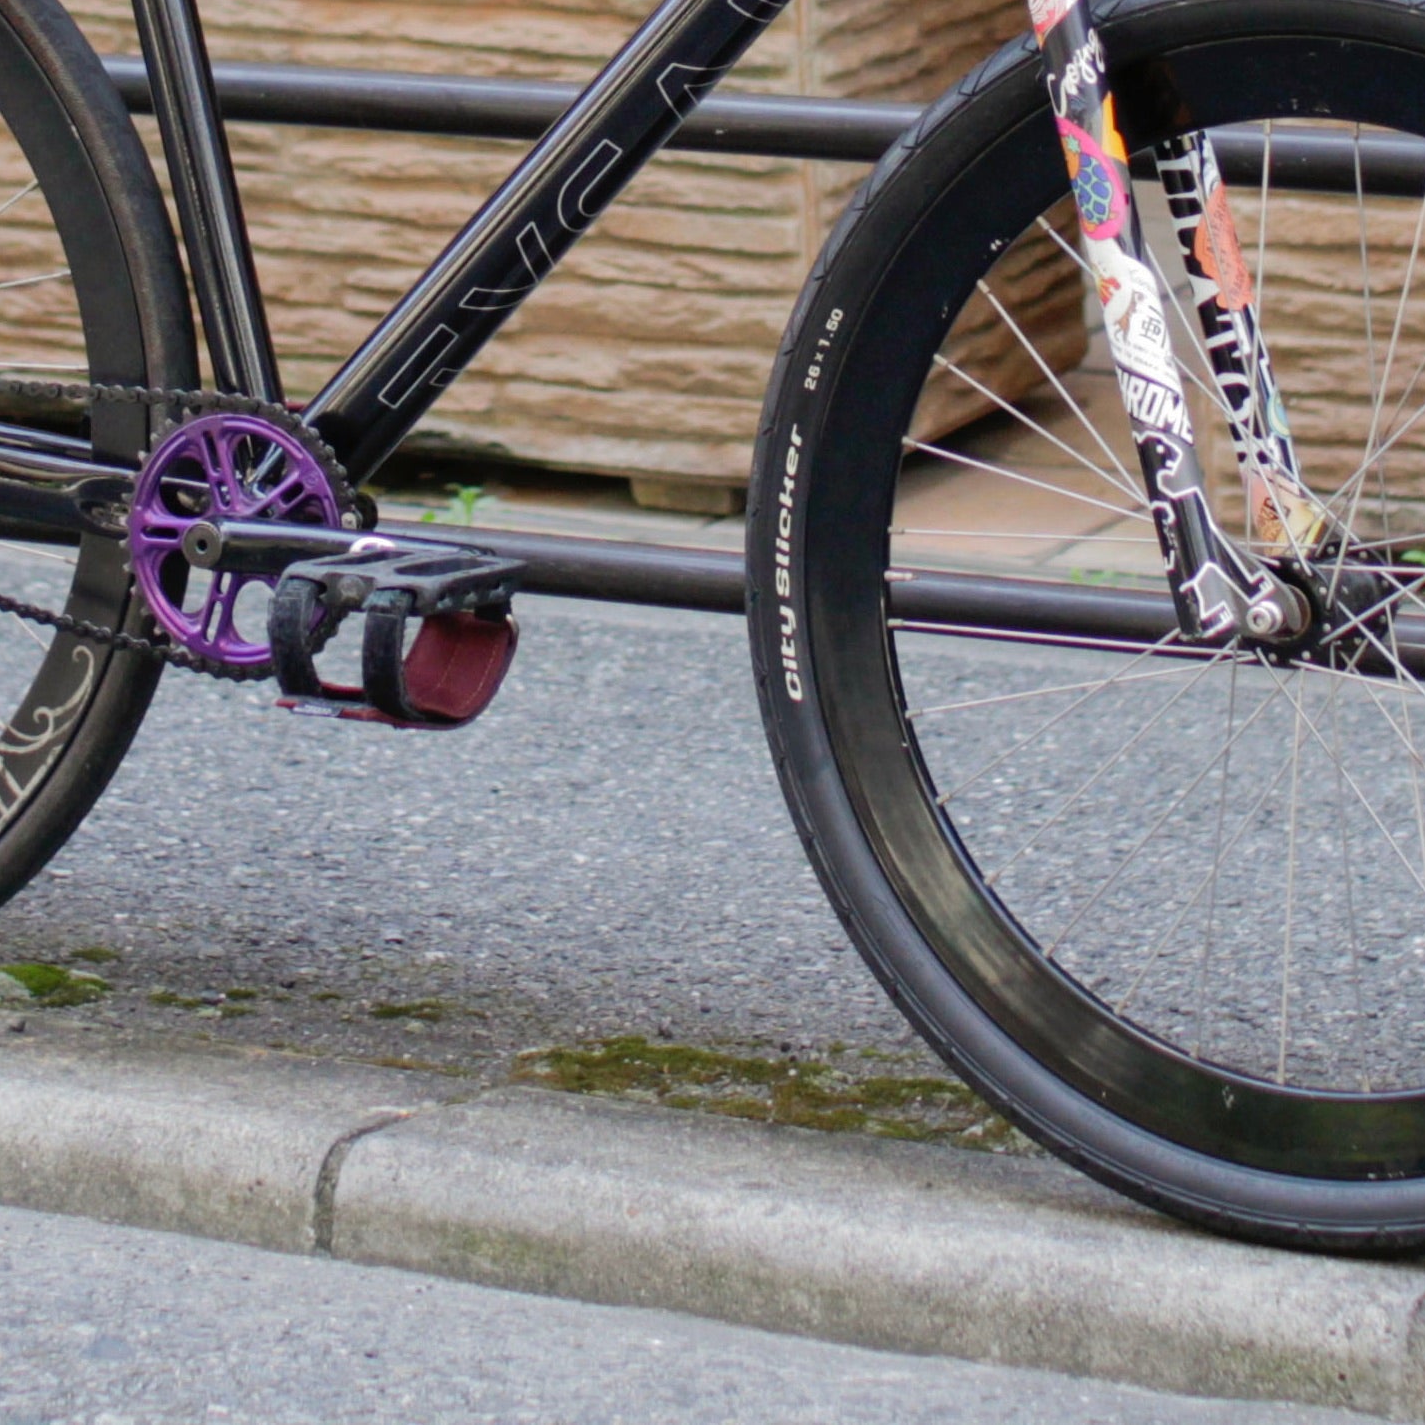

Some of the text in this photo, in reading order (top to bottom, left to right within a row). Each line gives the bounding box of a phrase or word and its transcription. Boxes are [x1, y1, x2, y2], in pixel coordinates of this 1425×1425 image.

[1116, 368, 1194, 445] HROME
[775, 423, 803, 701] City Slicker
